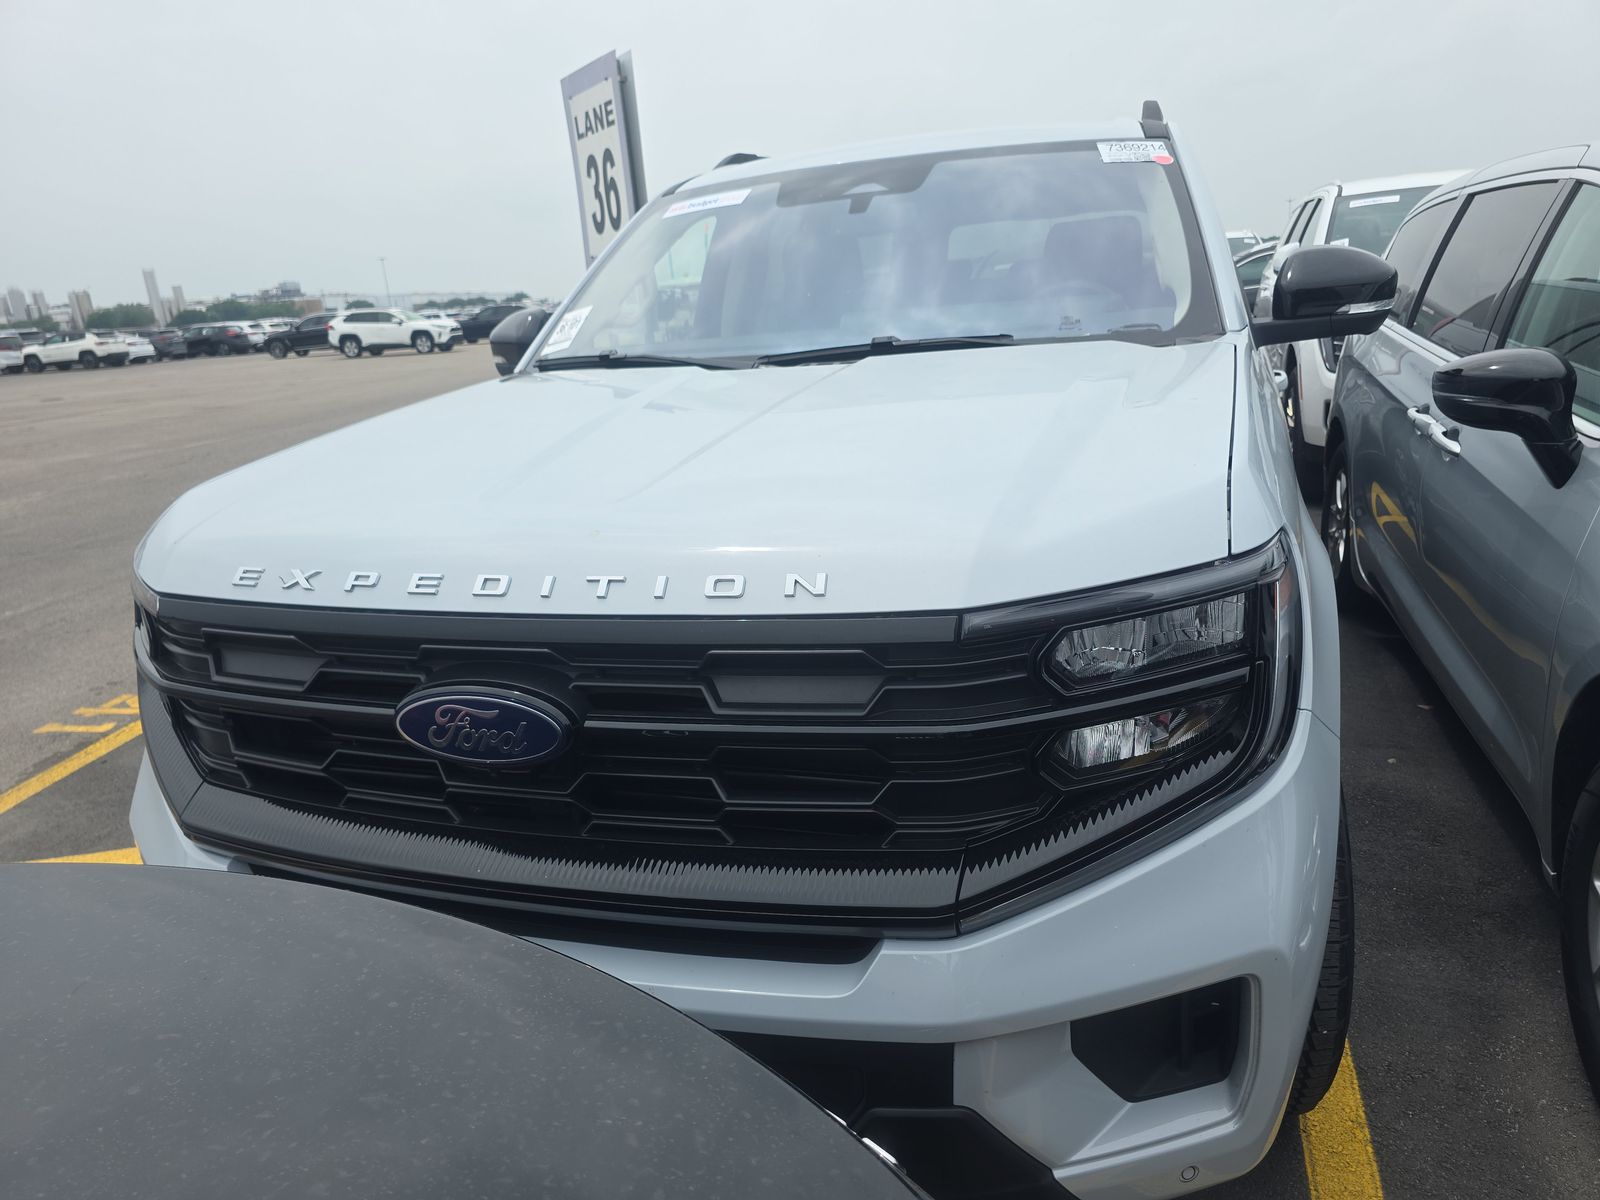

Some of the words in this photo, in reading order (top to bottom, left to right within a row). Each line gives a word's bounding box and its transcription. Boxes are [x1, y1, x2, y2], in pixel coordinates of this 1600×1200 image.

[573, 99, 616, 141] LANE
[586, 148, 622, 235] 36
[231, 566, 828, 601] EXPEDITION
[427, 704, 528, 755] Ford
